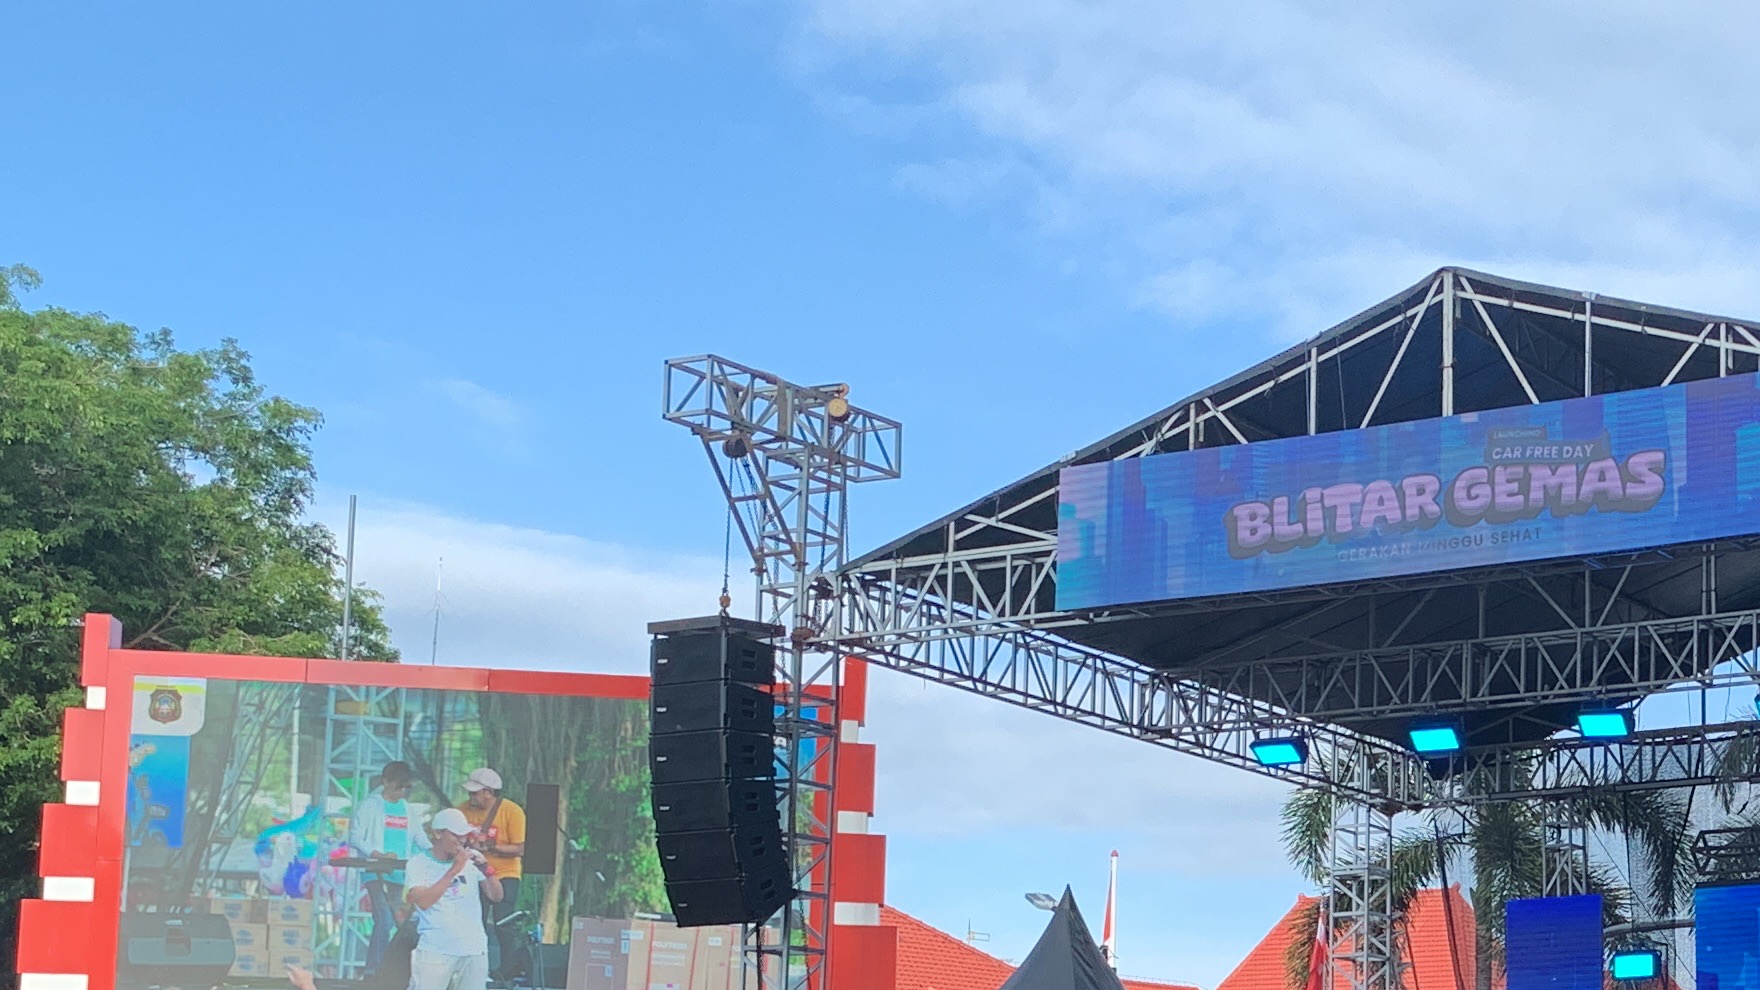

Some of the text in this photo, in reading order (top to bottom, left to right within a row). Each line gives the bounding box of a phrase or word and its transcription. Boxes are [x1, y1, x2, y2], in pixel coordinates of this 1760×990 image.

[1491, 443, 1595, 460] CAR FREE DAY
[1453, 450, 1666, 517] GEMAS
[1337, 527, 1541, 562] GERAKAN MINGGU SEHAT
